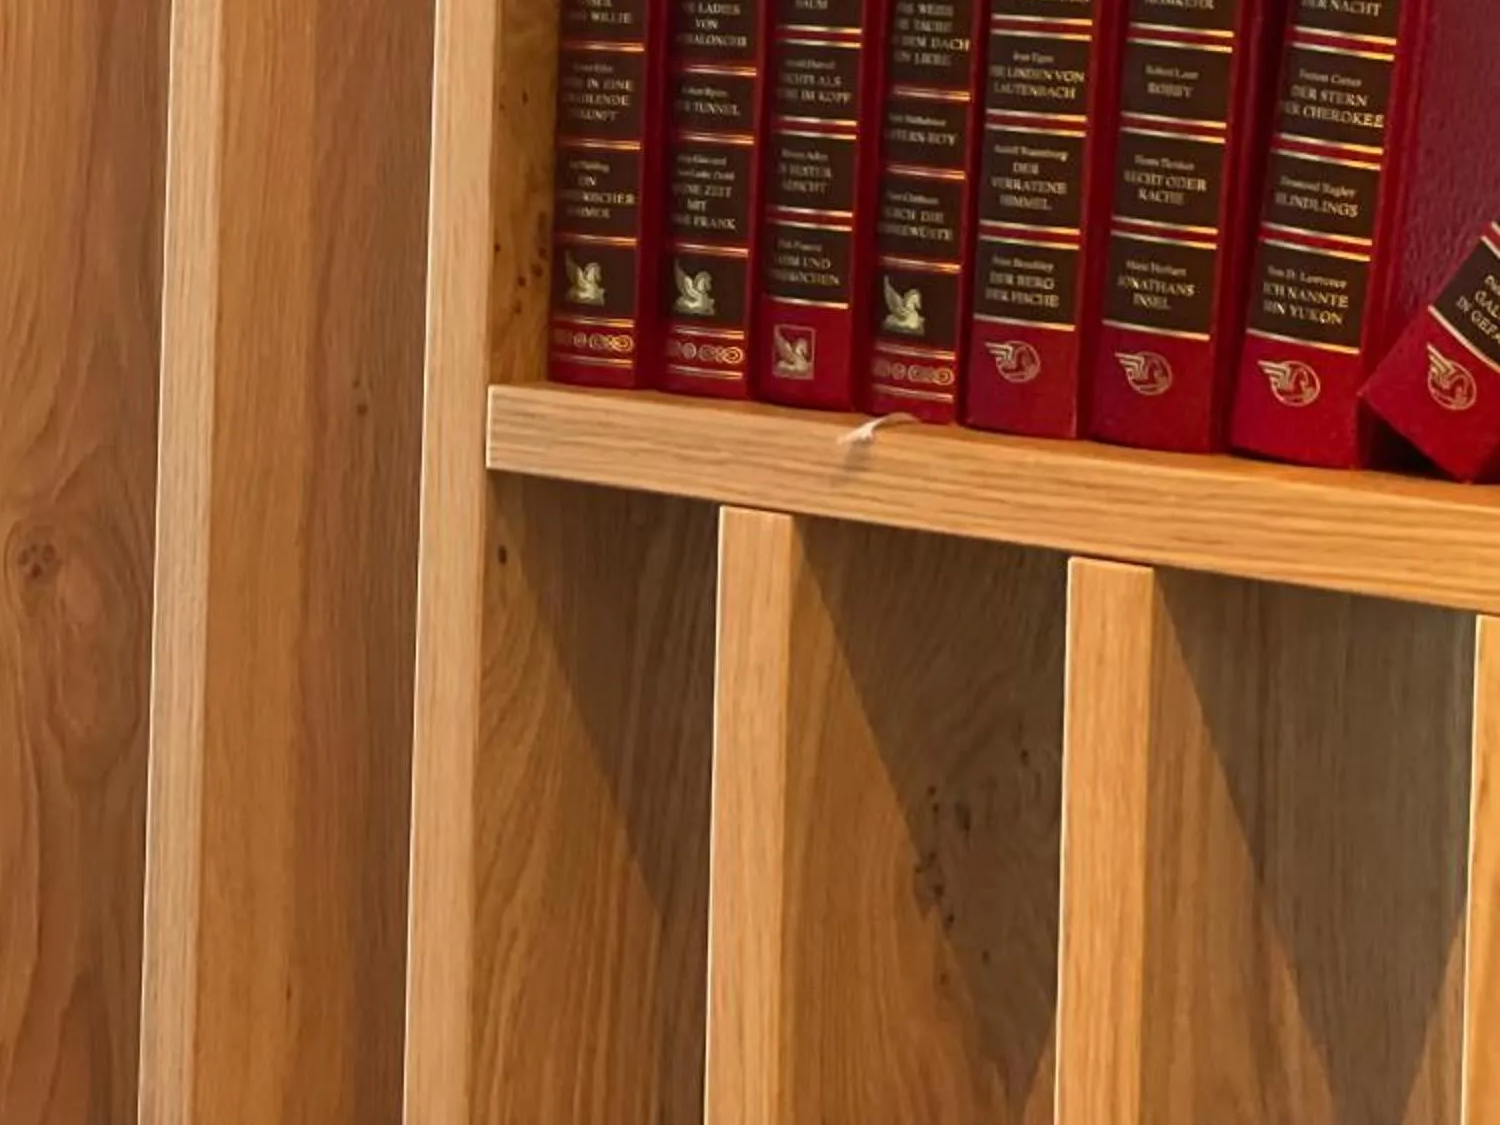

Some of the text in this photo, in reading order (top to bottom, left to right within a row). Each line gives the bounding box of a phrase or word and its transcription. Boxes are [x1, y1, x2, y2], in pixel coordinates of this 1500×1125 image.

[994, 83, 1076, 100] LAUTENBACH
[1319, 88, 1367, 108] STERN
[694, 101, 741, 116] TUNNEL
[1303, 103, 1385, 128] CHEROKEE
[991, 177, 1067, 195] VERRATENE
[1000, 195, 1052, 211] HIMMEL
[1274, 192, 1360, 219] BLINDLINGS
[693, 215, 737, 231] FRANK
[1117, 275, 1195, 296] JONATHANS
[1011, 290, 1059, 308] FISCHE
[1286, 285, 1349, 309] NANNTE
[1289, 304, 1344, 326] YUKON
